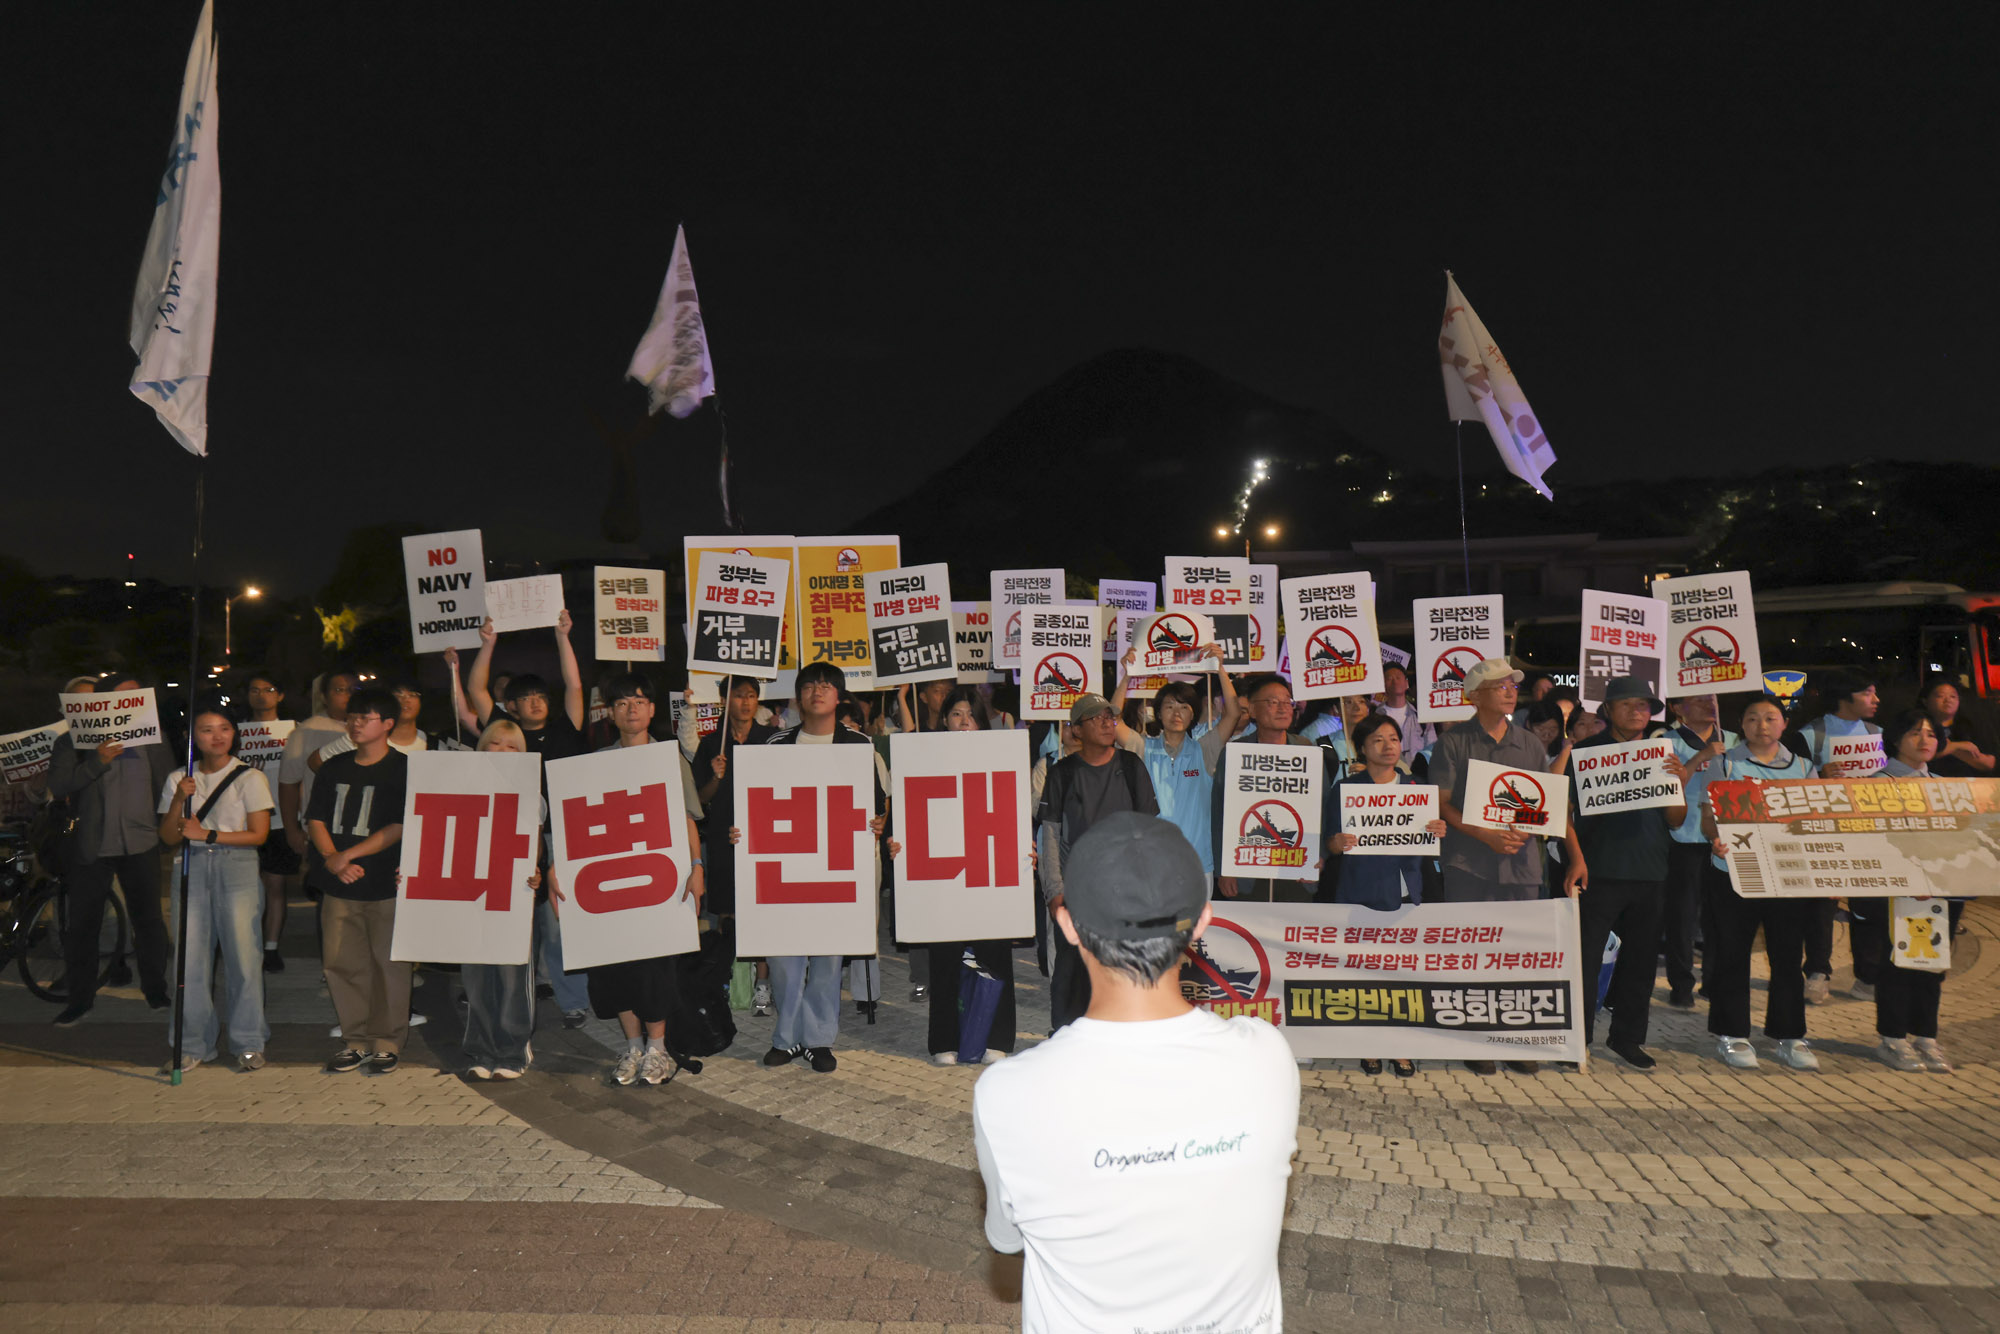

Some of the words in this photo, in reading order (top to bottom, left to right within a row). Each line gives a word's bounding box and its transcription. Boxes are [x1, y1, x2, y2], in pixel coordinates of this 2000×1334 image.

[427, 547, 457, 567] NO
[418, 572, 472, 594] NAVY
[719, 564, 767, 585] 정부는
[809, 575, 849, 590] 이재명
[1004, 577, 1051, 590] 침략전쟁
[1183, 567, 1231, 584] 정부는
[599, 578, 648, 595] 침략을
[880, 575, 925, 596] 미국의
[1298, 584, 1355, 603] 침략전쟁
[706, 585, 739, 604] 파병
[741, 589, 775, 607] 요구
[1004, 593, 1051, 605] 가담하는
[1106, 598, 1147, 611] 거부하라!
[1173, 588, 1206, 605] 파병
[1209, 588, 1242, 605] 요구
[1670, 586, 1733, 606] 파병논의
[438, 600, 456, 613] TO
[873, 599, 904, 618] 파병
[907, 595, 941, 614] 압박
[1300, 604, 1358, 621] 가담하는
[1429, 606, 1489, 623] 침략전쟁
[1600, 605, 1645, 626] 미국의
[1671, 604, 1738, 624] 중단하라!
[418, 616, 481, 635] HORMUZ!
[599, 616, 649, 635] 전쟁을
[703, 615, 746, 636] 거부
[966, 612, 988, 625] NO
[1033, 613, 1089, 629] 굴종외교
[878, 625, 919, 653] 규탄
[1031, 632, 1091, 648] 중단하라!
[1430, 625, 1490, 642] 가담하는
[1590, 625, 1622, 646] 파병
[1625, 629, 1657, 650] 압박
[717, 638, 771, 661] 하라!
[895, 642, 947, 672] 한다!
[970, 648, 983, 658] TO
[1306, 664, 1366, 686] 파병반대
[1589, 655, 1632, 677] 규탄
[1680, 664, 1744, 685] 파병반대
[66, 703, 82, 713] DO
[85, 701, 110, 712] NOT
[113, 696, 144, 710] JOIN
[71, 719, 78, 729] A
[81, 717, 110, 728] WAR
[114, 714, 132, 726] OF
[1578, 758, 1597, 772] DO
[1601, 752, 1629, 768] NOT
[1631, 746, 1664, 762] JOIN
[1833, 745, 1852, 755] NO
[1241, 754, 1307, 773] 파병논의
[1238, 775, 1309, 794] 중단하라!
[1582, 778, 1592, 790] A
[1594, 771, 1629, 788] WAR
[1633, 767, 1651, 781] OF
[1345, 796, 1365, 808] DO
[1368, 795, 1396, 807] NOT
[1398, 794, 1429, 806] JOIN
[1585, 783, 1678, 808] AGGRESSION!
[1763, 783, 1851, 818] 호르무즈
[1852, 782, 1927, 814] 전쟁행
[1926, 782, 1977, 813] 티켓
[1346, 816, 1356, 827] A
[1361, 814, 1393, 827] WAR
[1396, 814, 1414, 826] OF
[1486, 806, 1546, 825] 파병반대
[1801, 819, 1835, 832] 국민을
[1838, 818, 1888, 832] 전쟁터로
[904, 771, 1019, 888] 대
[562, 782, 678, 914] 병
[747, 785, 866, 904] 반
[1355, 833, 1435, 847] GGRESSION!
[1804, 842, 1845, 853] 대한민국
[406, 793, 530, 911] 파
[1238, 847, 1304, 866] 파병반대
[1809, 860, 1850, 870] 호르무즈
[1851, 859, 1882, 870] 전쟁터
[1814, 877, 1843, 888] 한국군
[1850, 877, 1888, 888] 대한민국
[1889, 876, 1909, 887] 국민
[1284, 926, 1338, 943] 미국은
[1344, 926, 1418, 944] 침략전쟁
[1423, 927, 1504, 944] 중단하라!
[1284, 951, 1339, 969] 정부는
[1344, 953, 1419, 971] 파병압박
[1424, 953, 1477, 971] 단호히
[1484, 952, 1564, 970] 거부하라!
[1290, 987, 1425, 1023] 파병반대
[1430, 988, 1565, 1025] 평화행진
[1485, 1035, 1566, 1046] 기자회견&평화행진
[1094, 1143, 1177, 1172] Organized
[1183, 1132, 1251, 1159] Comfort
